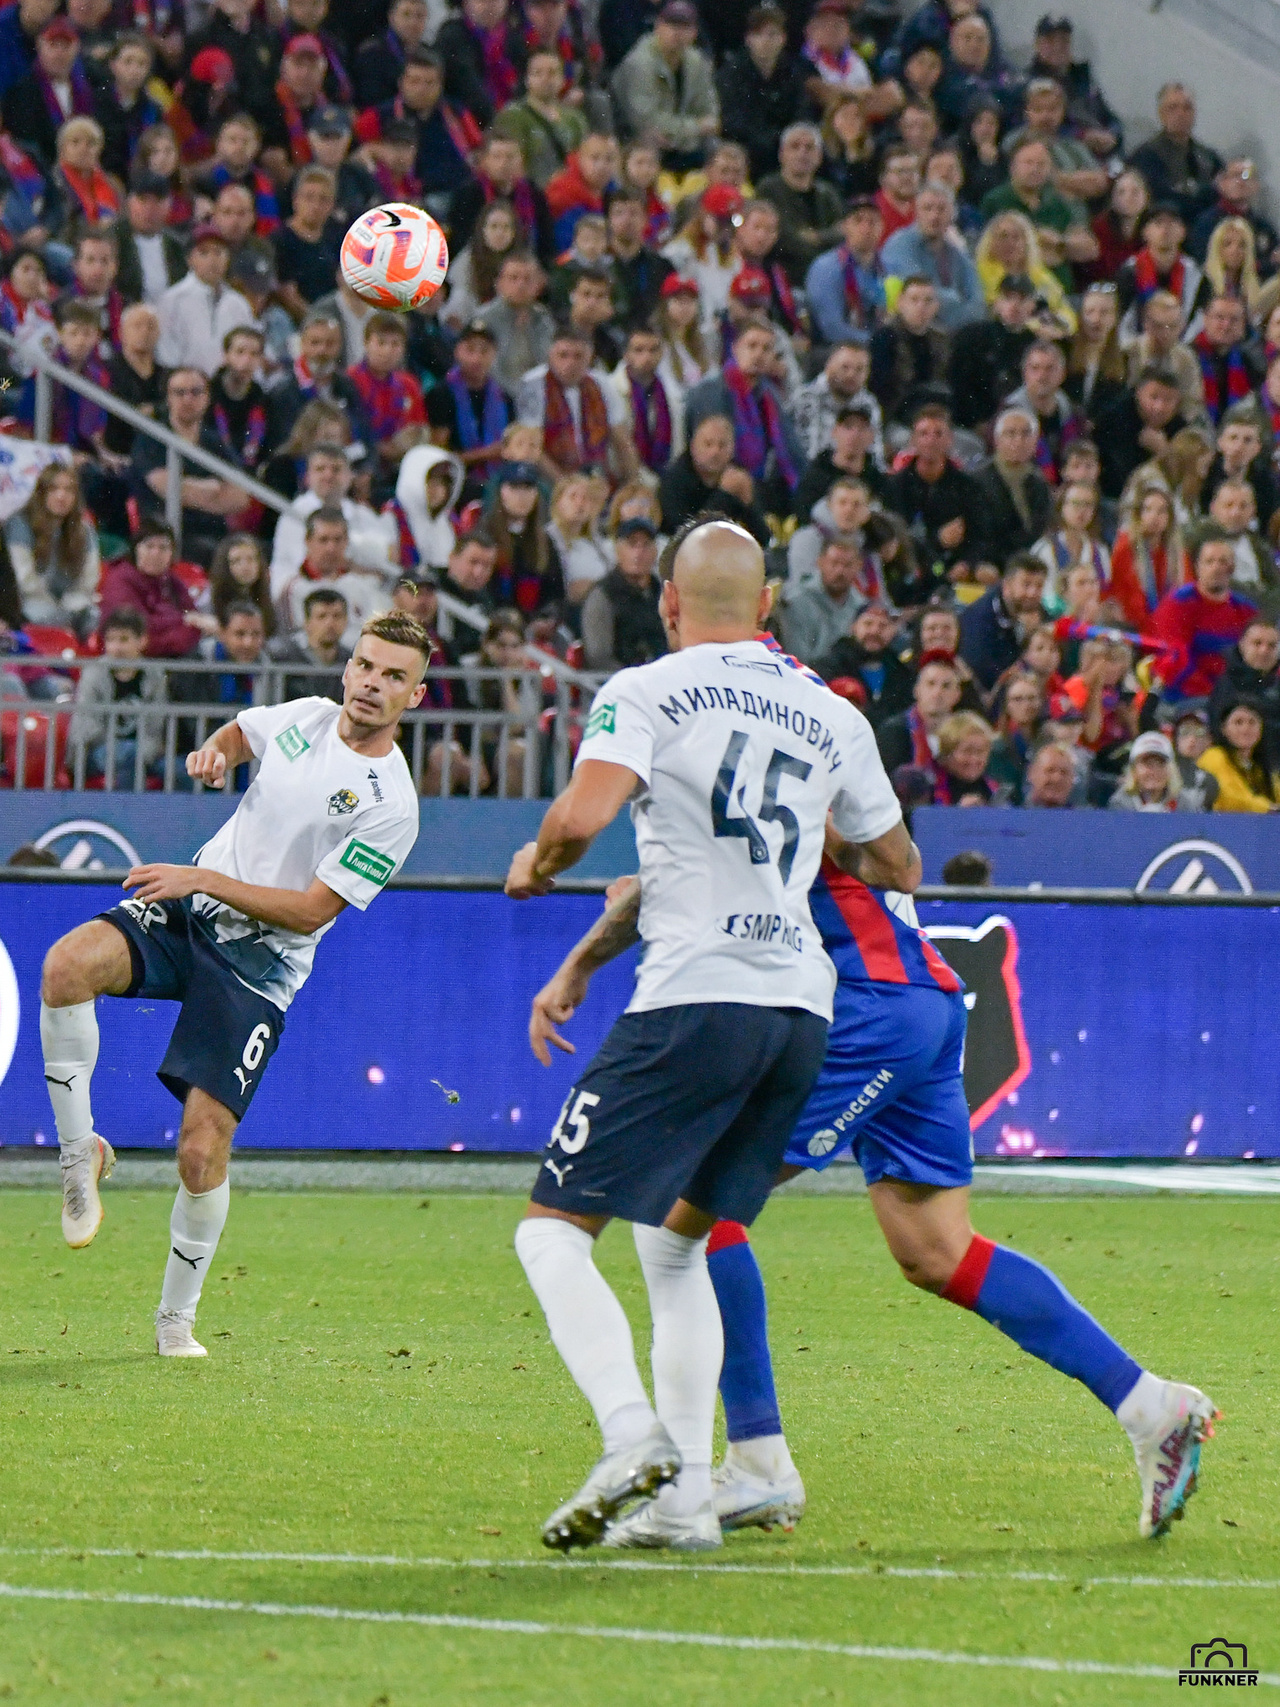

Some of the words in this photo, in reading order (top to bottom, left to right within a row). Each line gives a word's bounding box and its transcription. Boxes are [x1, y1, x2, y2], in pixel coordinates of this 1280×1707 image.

[658, 686, 842, 773] МИЛАДИНОВИЧ
[711, 729, 814, 888] 45
[740, 914, 781, 942] SMP
[242, 1023, 270, 1071] 6
[833, 1069, 894, 1131] РОССЕТИ
